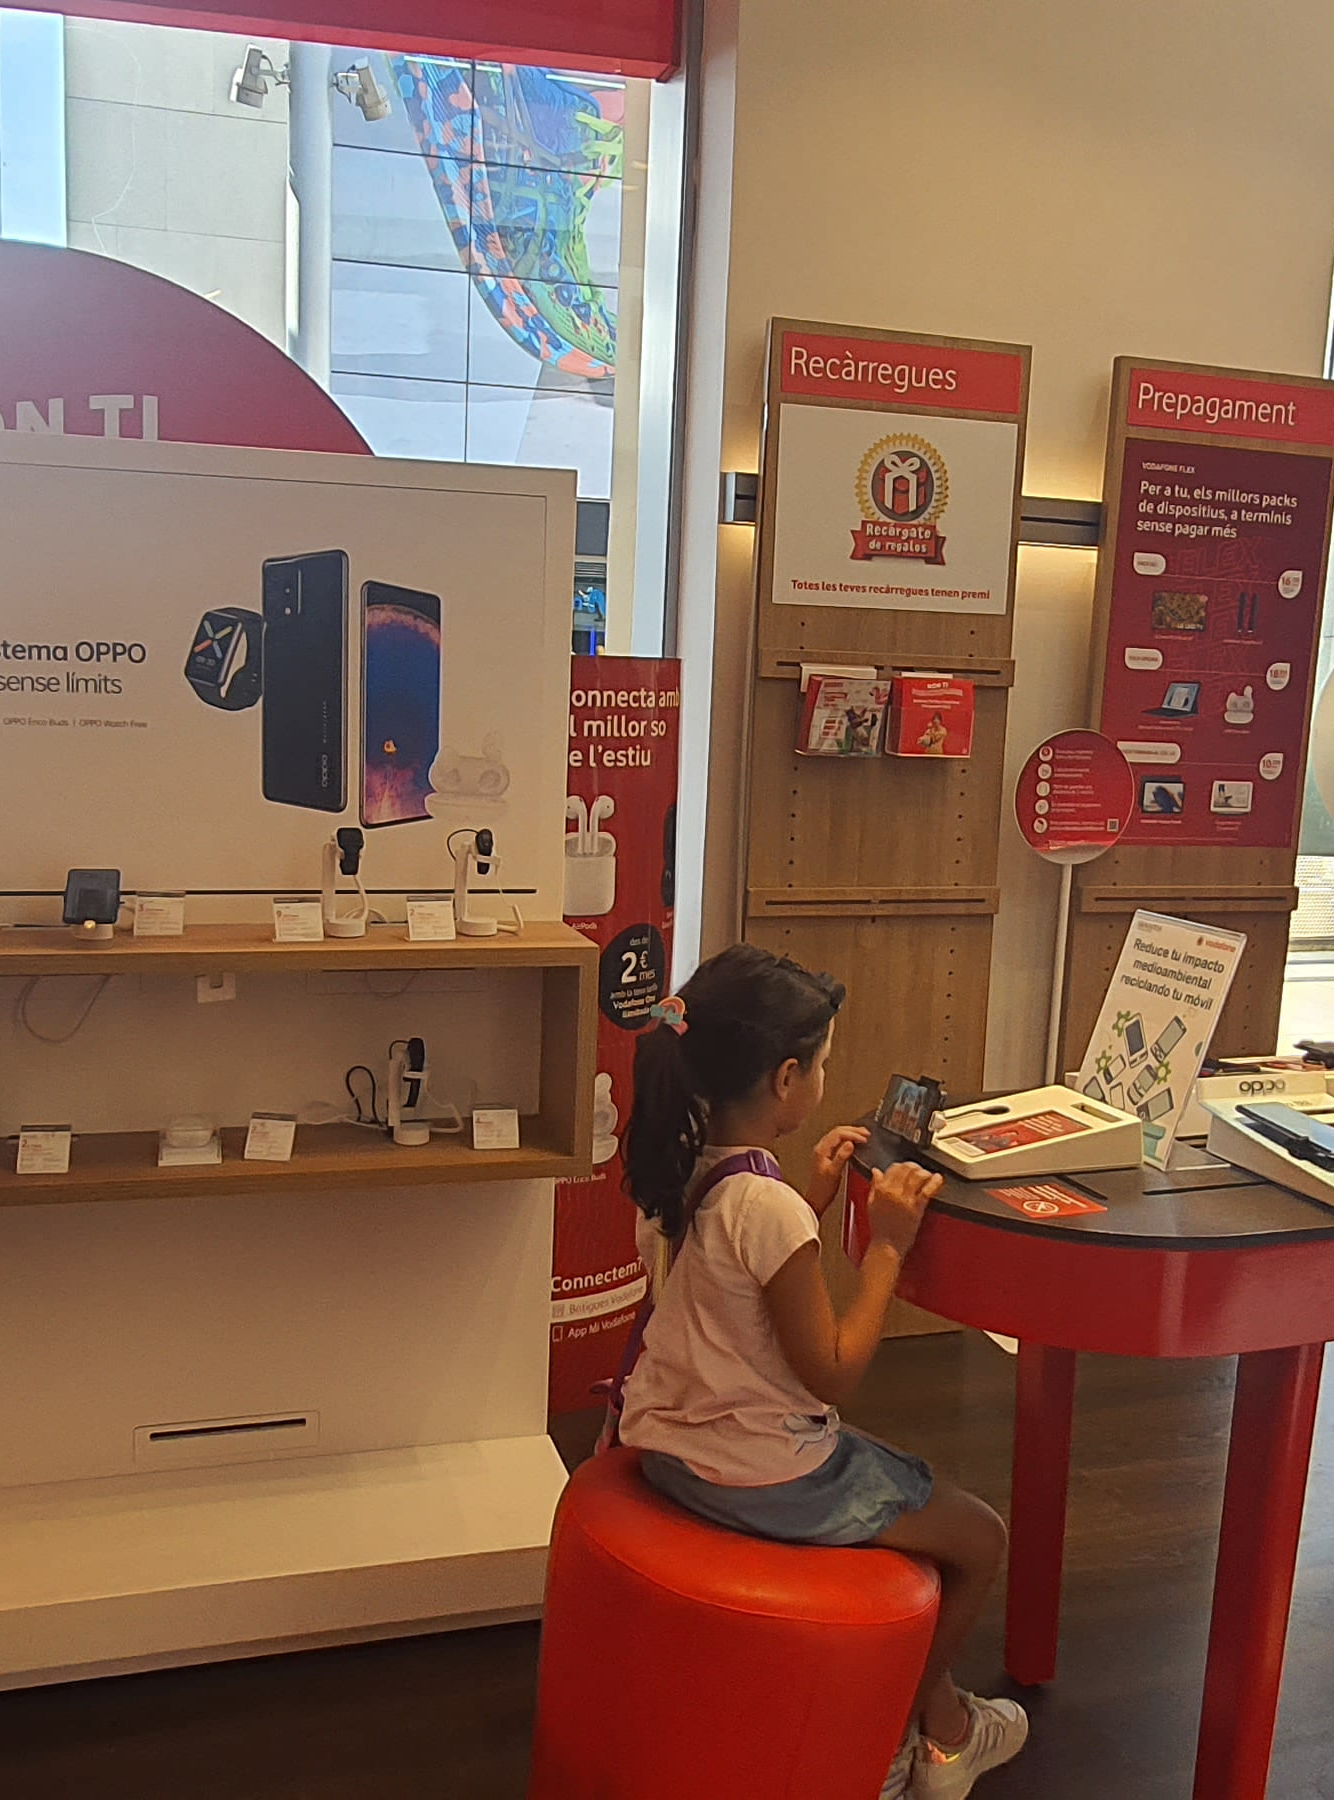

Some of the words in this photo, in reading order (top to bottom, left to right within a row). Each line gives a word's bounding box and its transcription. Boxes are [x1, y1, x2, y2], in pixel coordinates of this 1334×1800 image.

[790, 346, 958, 393] Recàrregues
[1138, 382, 1297, 426] Prepagament
[1140, 480, 1162, 495] Per
[1164, 486, 1171, 497] a
[1174, 485, 1190, 499] tu,
[1193, 486, 1213, 499] els
[1215, 488, 1260, 504] millors
[1262, 494, 1298, 509] packs
[1138, 500, 1154, 513] de
[1157, 501, 1228, 521] dispositius,
[1230, 509, 1238, 520] a
[1241, 508, 1292, 525] terminis
[1137, 519, 1173, 533] sense
[1174, 521, 1209, 538] pagar
[1211, 524, 1238, 538] més
[868, 541, 881, 551] de
[791, 580, 819, 591] Totes
[822, 581, 837, 592] les
[839, 582, 867, 593] teves
[931, 587, 960, 598] tenen
[961, 589, 990, 600] premi
[75, 641, 147, 664] OPPO
[66, 671, 123, 694] límits
[571, 687, 656, 708] onnecta
[583, 714, 647, 737] millor
[650, 720, 667, 736] so
[589, 744, 651, 768] l'estiu
[1133, 938, 1169, 958] Reduce
[1170, 948, 1182, 961] tu
[1182, 951, 1225, 974] impacto
[1132, 959, 1212, 990] medioambiental
[1120, 974, 1170, 998] reciclando
[1171, 987, 1183, 1001] tu
[1183, 993, 1214, 1010] móvil
[1239, 1078, 1285, 1095] oppo
[567, 1325, 587, 1339] App
[601, 1311, 636, 1331] Vodafone
